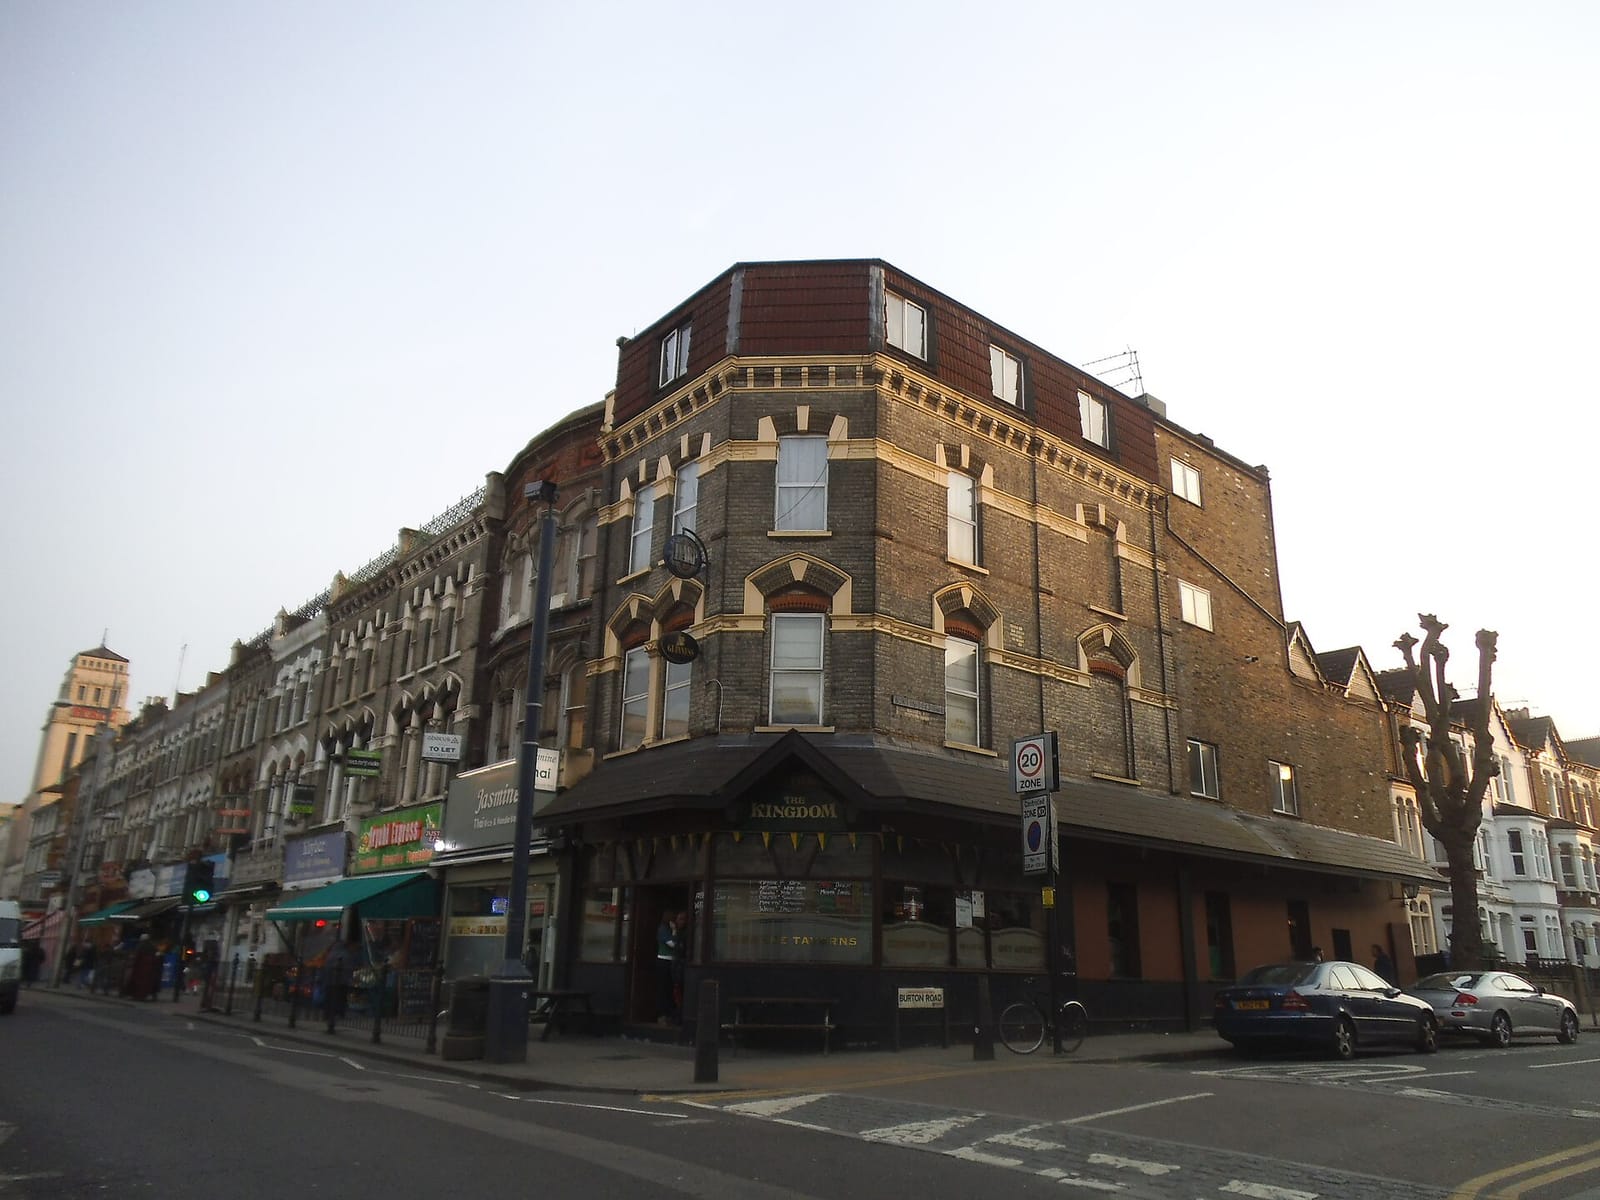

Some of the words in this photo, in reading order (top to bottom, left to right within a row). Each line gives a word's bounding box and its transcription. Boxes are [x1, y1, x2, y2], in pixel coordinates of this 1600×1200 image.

[1022, 753, 1038, 767] 20
[1020, 779, 1041, 788] ZONE
[475, 783, 519, 814] Jasmine
[751, 802, 838, 818] KINGDOM
[900, 994, 924, 1002] BURTON
[926, 994, 943, 1002] ROAD
